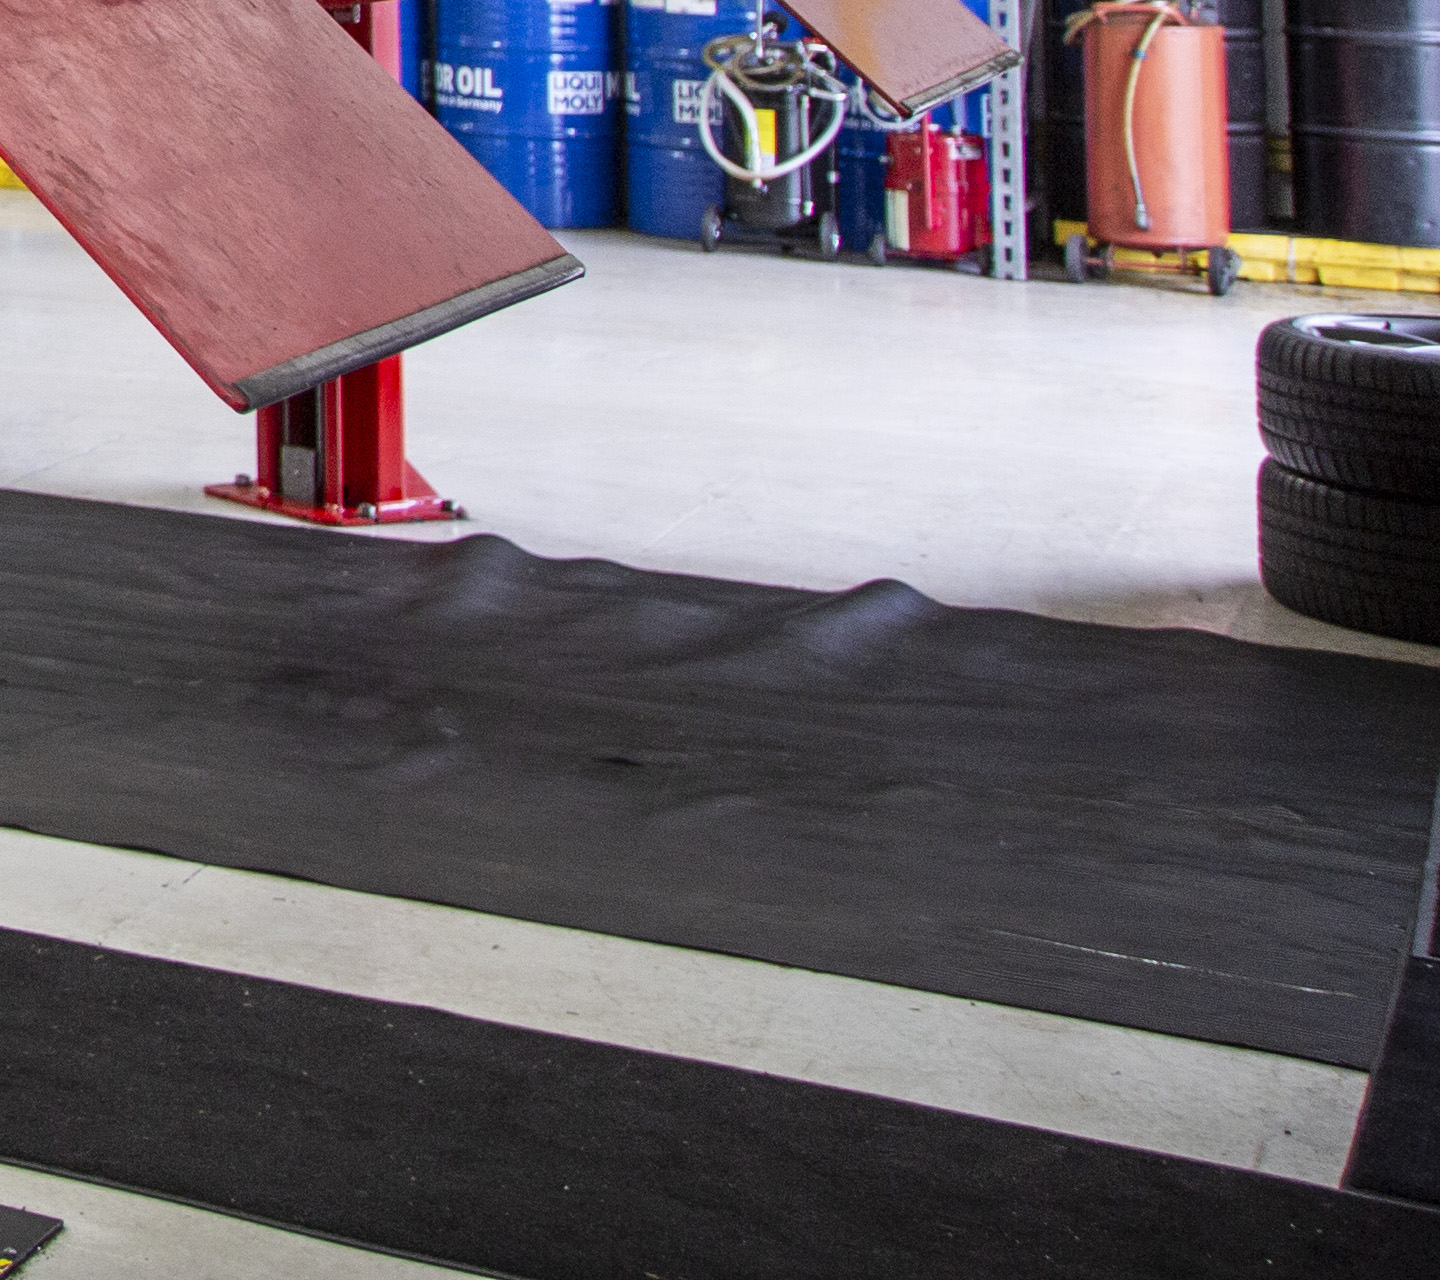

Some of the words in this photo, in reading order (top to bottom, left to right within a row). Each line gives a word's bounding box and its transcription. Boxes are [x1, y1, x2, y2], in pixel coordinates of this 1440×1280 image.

[456, 66, 504, 98] OIL
[553, 73, 601, 89] LIQUI
[553, 93, 601, 110] MOLY
